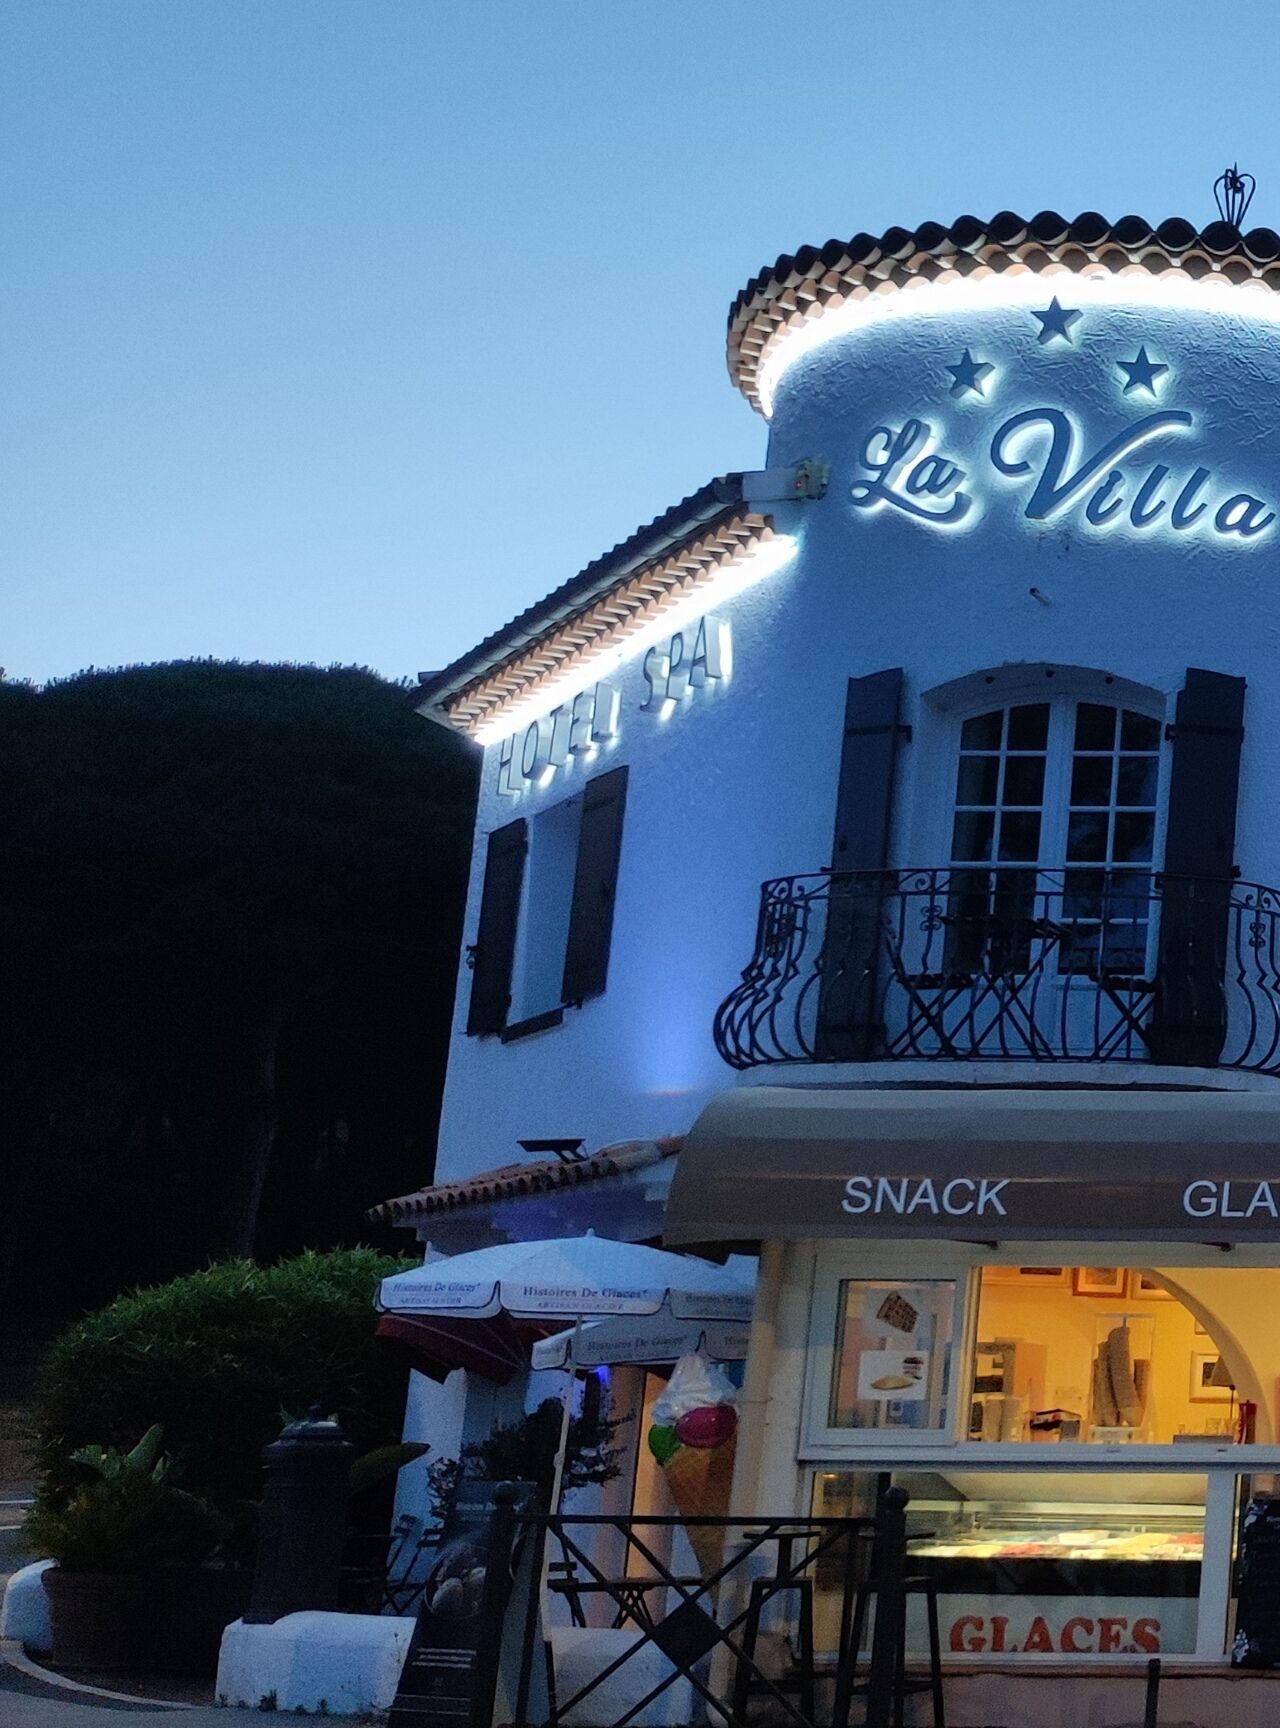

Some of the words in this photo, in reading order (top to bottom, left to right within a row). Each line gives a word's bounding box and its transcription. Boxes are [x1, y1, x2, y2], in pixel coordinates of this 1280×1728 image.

[850, 418, 972, 527] La
[990, 408, 1275, 537] Villa
[497, 681, 615, 796] HOTEL
[640, 615, 722, 712] SPA
[841, 1176, 1011, 1215] SNACK
[523, 1286, 577, 1297] Histoires
[581, 1287, 598, 1297] De
[949, 1615, 1161, 1653] GLACES
